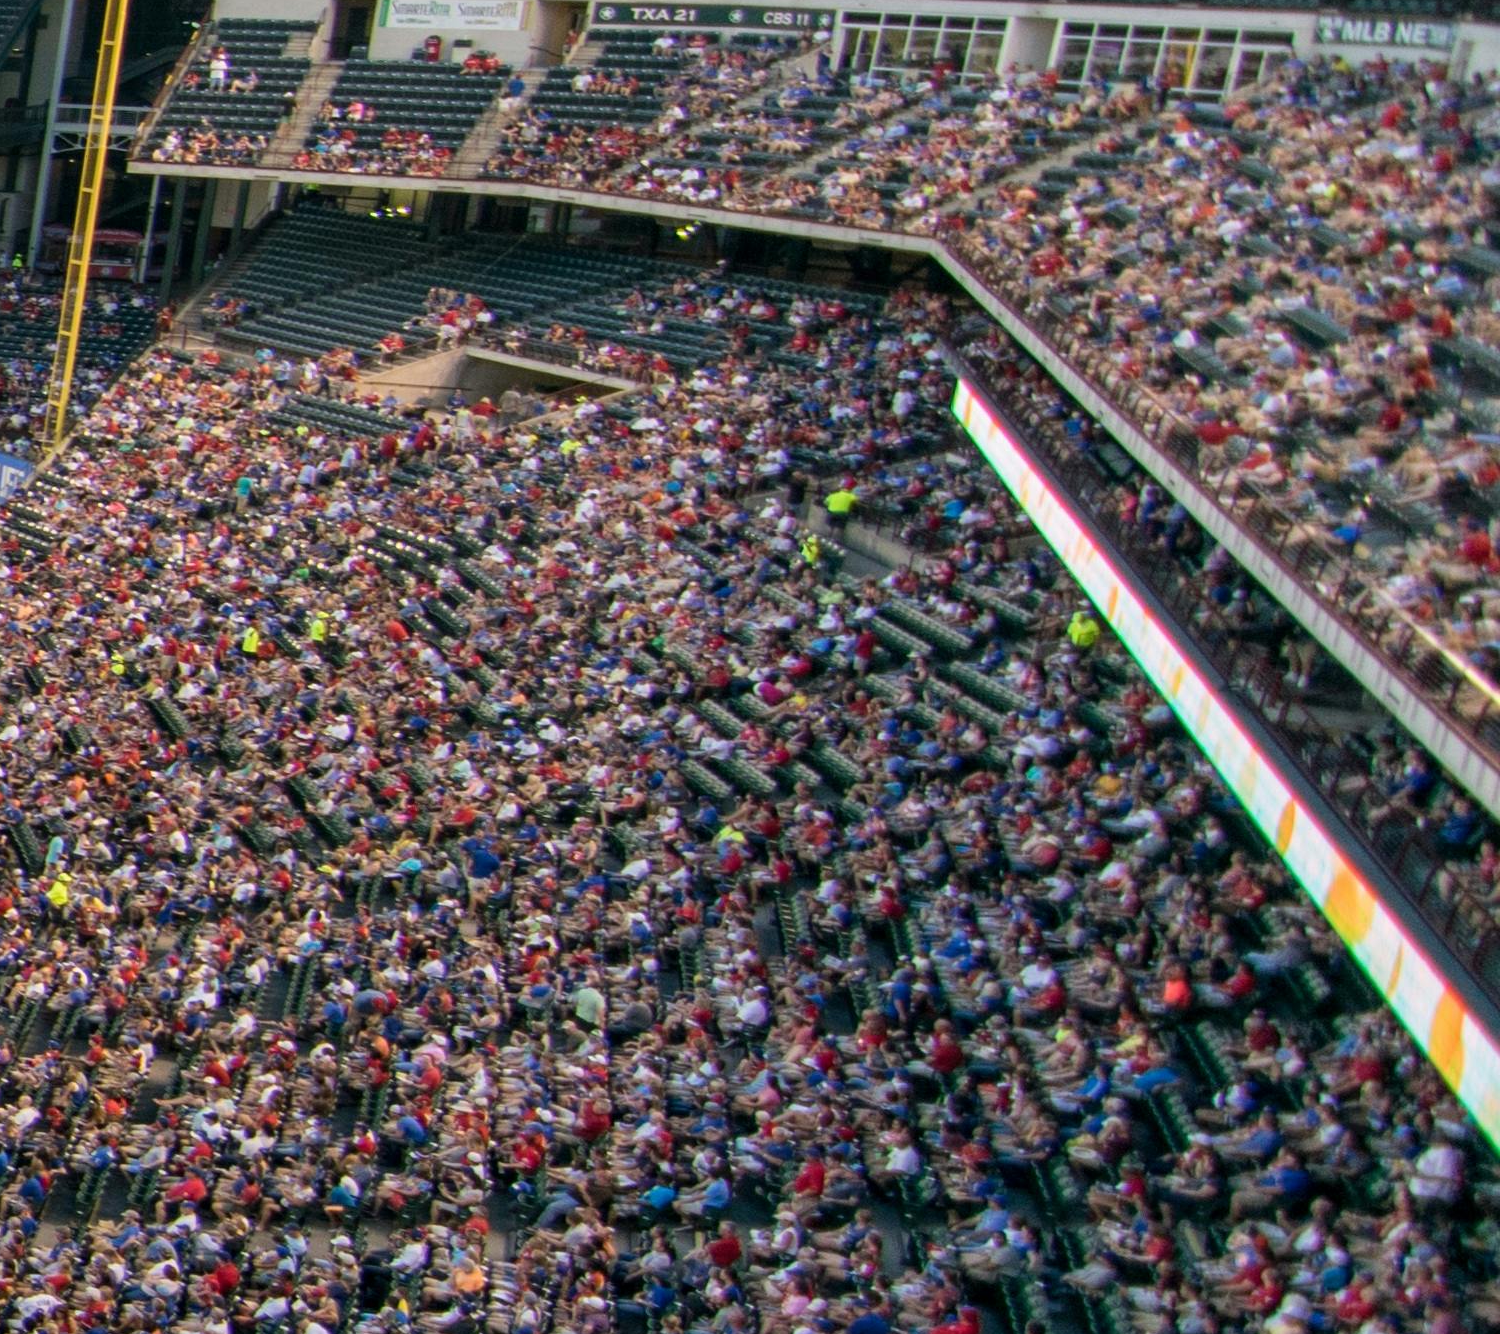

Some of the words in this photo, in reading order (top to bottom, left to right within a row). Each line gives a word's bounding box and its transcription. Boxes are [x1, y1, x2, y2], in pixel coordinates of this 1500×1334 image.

[631, 8, 669, 21] TXA
[674, 8, 697, 22] 21
[763, 12, 794, 25] CBS
[798, 13, 808, 25] 11
[1342, 20, 1390, 43] MLB
